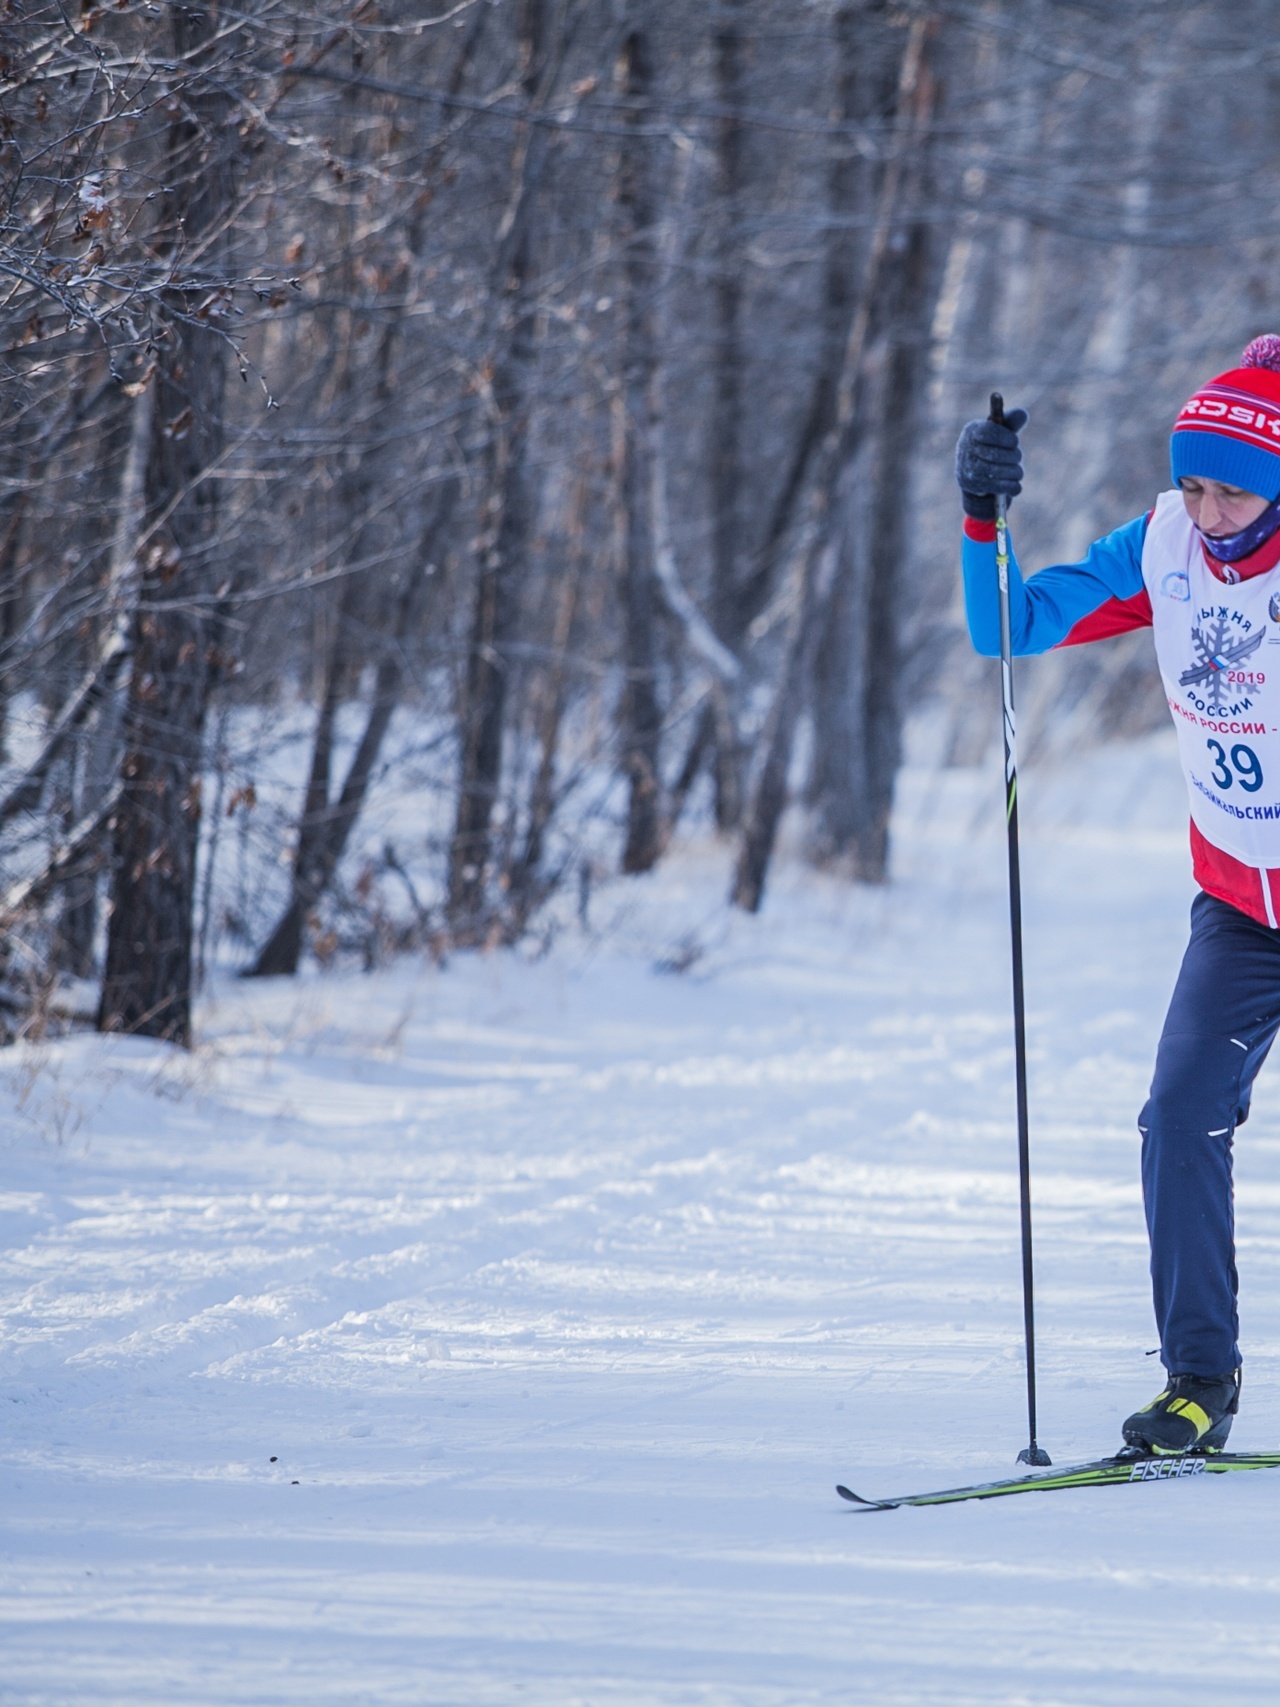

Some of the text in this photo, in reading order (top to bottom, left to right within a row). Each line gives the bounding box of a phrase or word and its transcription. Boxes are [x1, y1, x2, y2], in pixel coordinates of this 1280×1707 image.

[997, 532, 1008, 594] FISCER
[1228, 671, 1266, 685] 2019
[1187, 691, 1253, 718] РОССИИ
[1199, 717, 1266, 735] РОССИИ
[1206, 738, 1264, 792] 39
[1129, 1458, 1206, 1481] FISCHER
